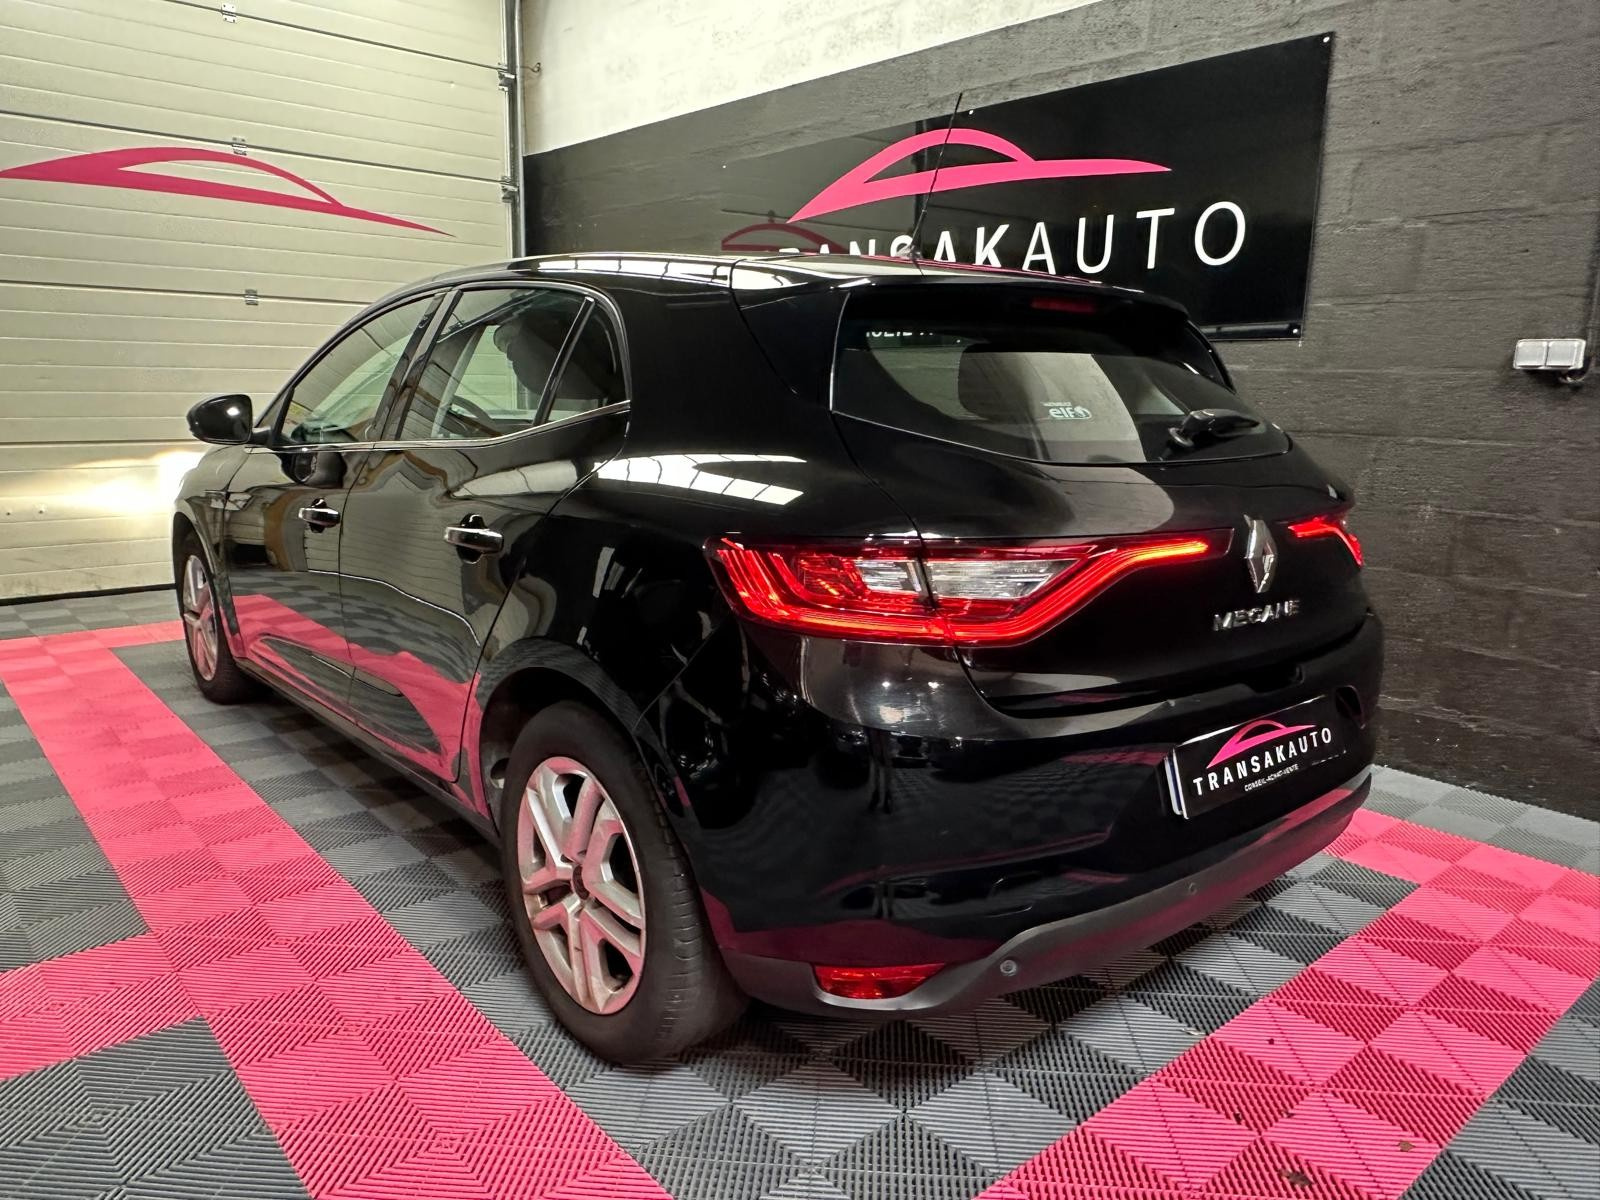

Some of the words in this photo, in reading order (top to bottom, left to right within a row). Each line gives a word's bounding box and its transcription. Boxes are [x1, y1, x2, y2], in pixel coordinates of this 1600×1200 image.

[778, 201, 1246, 276] AKAUTO
[1213, 600, 1299, 631] MEGANE
[1193, 727, 1332, 796] TRANSAKAUTO
